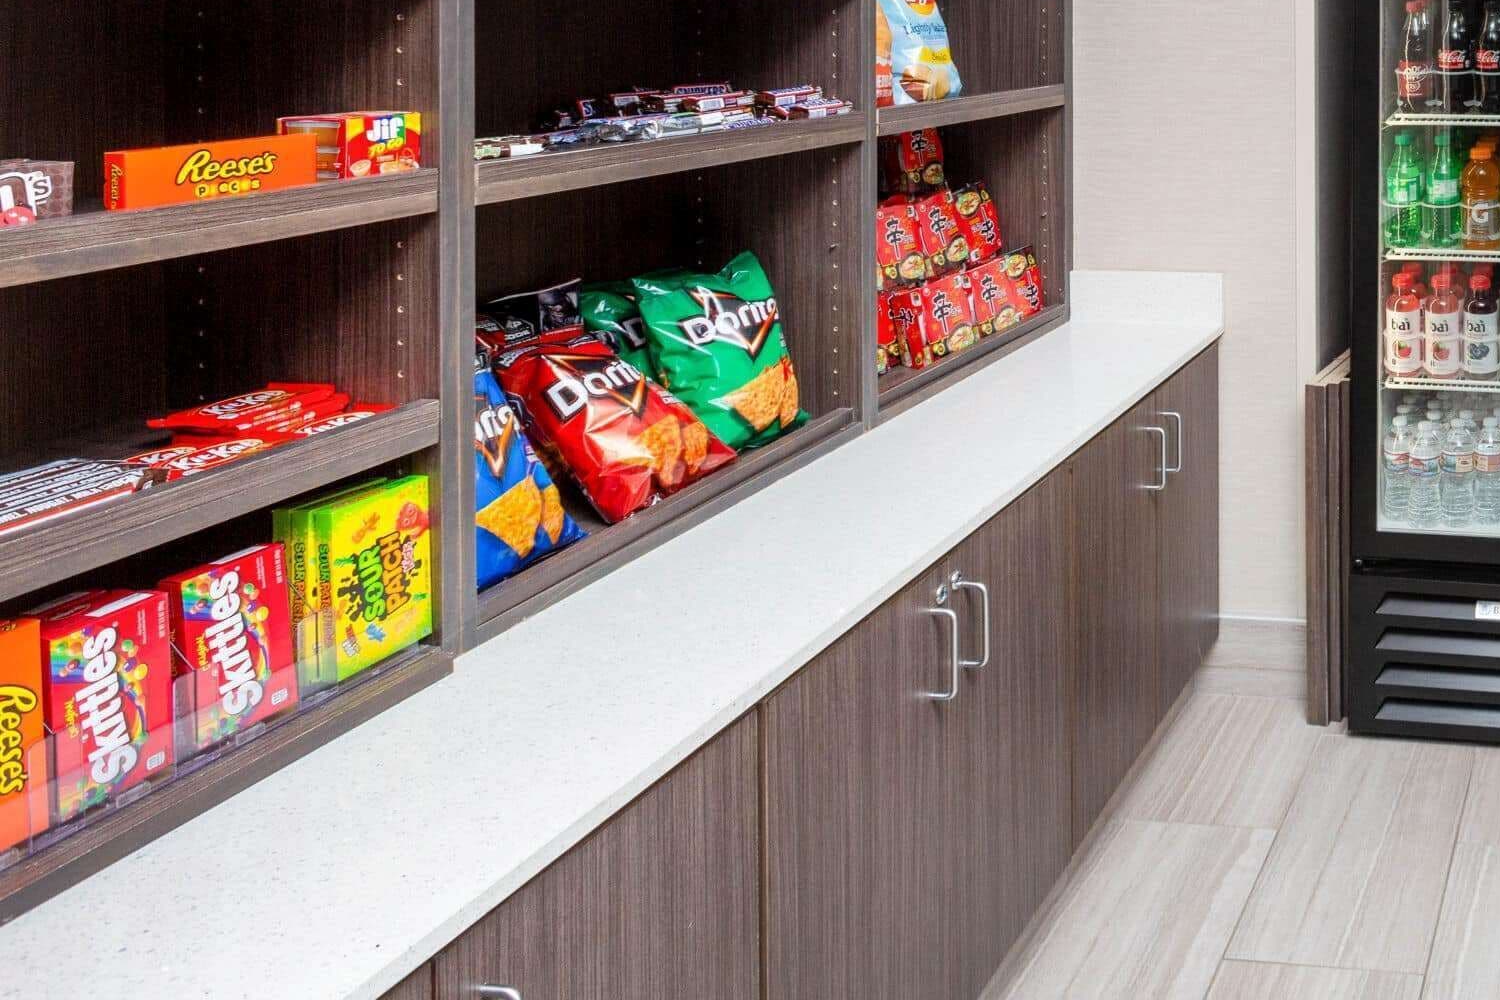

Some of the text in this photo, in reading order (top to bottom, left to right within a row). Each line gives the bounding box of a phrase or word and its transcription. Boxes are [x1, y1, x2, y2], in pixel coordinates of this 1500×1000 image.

[366, 116, 406, 142] Jif
[176, 150, 277, 185] Reese's
[1391, 318, 1410, 331] bai
[318, 543, 331, 581] SOUR
[358, 543, 386, 622] SOUR
[379, 530, 412, 615] PATCH
[204, 570, 263, 716] Skittles
[75, 626, 138, 784] Skittles
